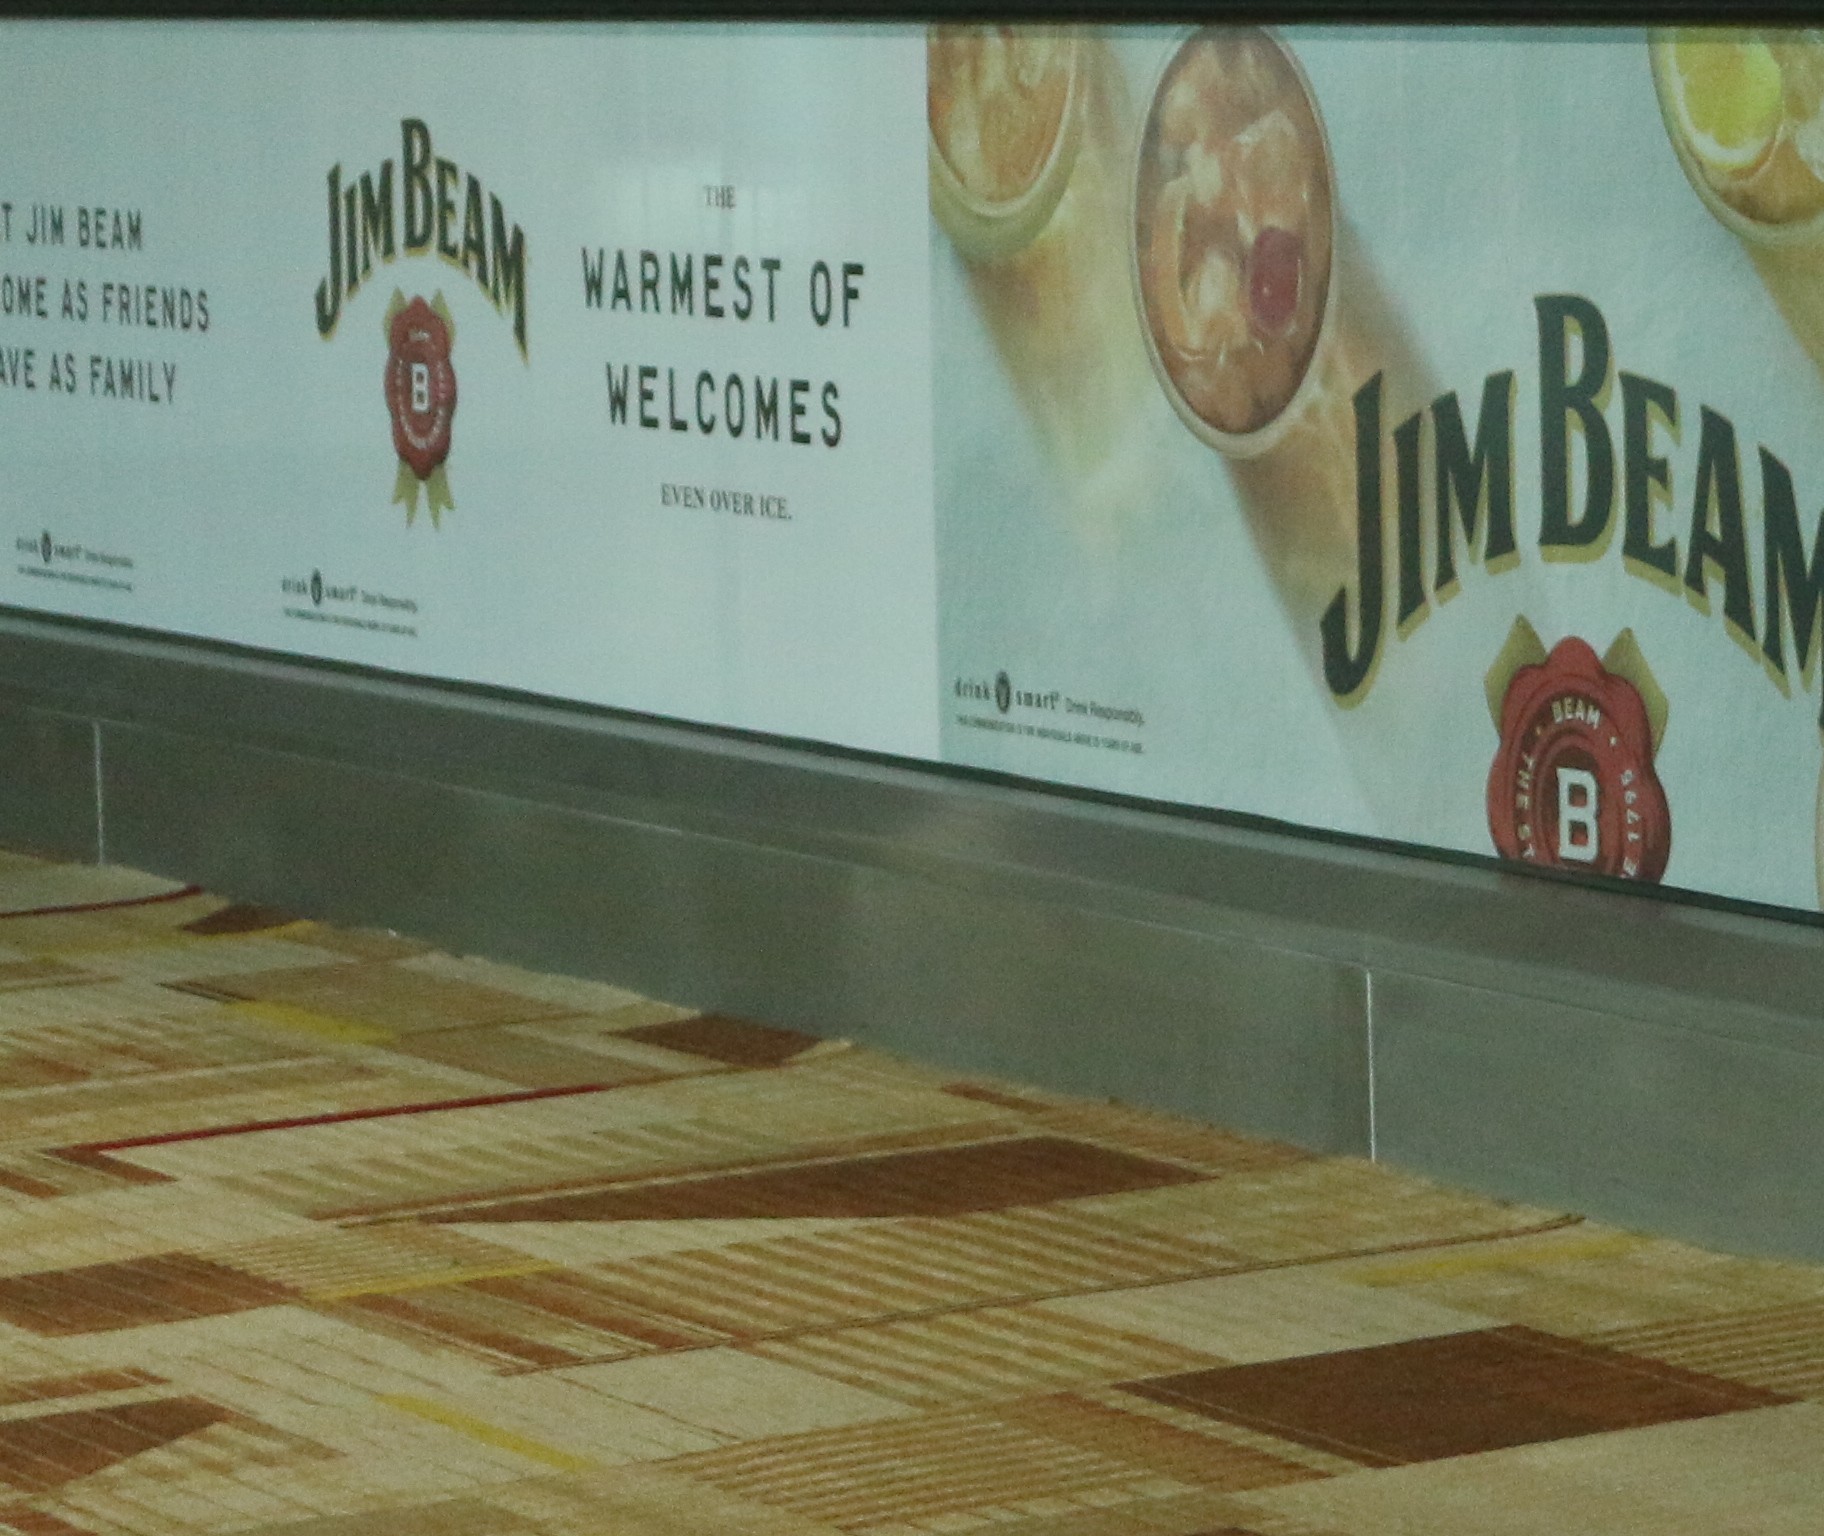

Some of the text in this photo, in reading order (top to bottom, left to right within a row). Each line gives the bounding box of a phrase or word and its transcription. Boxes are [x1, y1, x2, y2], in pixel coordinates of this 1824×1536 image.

[704, 185, 736, 210] THE
[26, 202, 65, 245] JIM
[78, 205, 142, 251] BEAM
[314, 117, 528, 366] JIM BEAM
[2, 273, 210, 333] OME AS FRIENDS
[581, 246, 864, 328] WARMEST OF
[50, 352, 77, 394] AS
[90, 354, 177, 404] FAMILY
[411, 362, 430, 414] B
[605, 361, 843, 448] WELCOMES
[660, 481, 794, 521] EVEN OVER ICE.
[1319, 369, 1522, 710] JIM
[1552, 696, 1601, 730] BEAM
[1556, 766, 1600, 864] B
